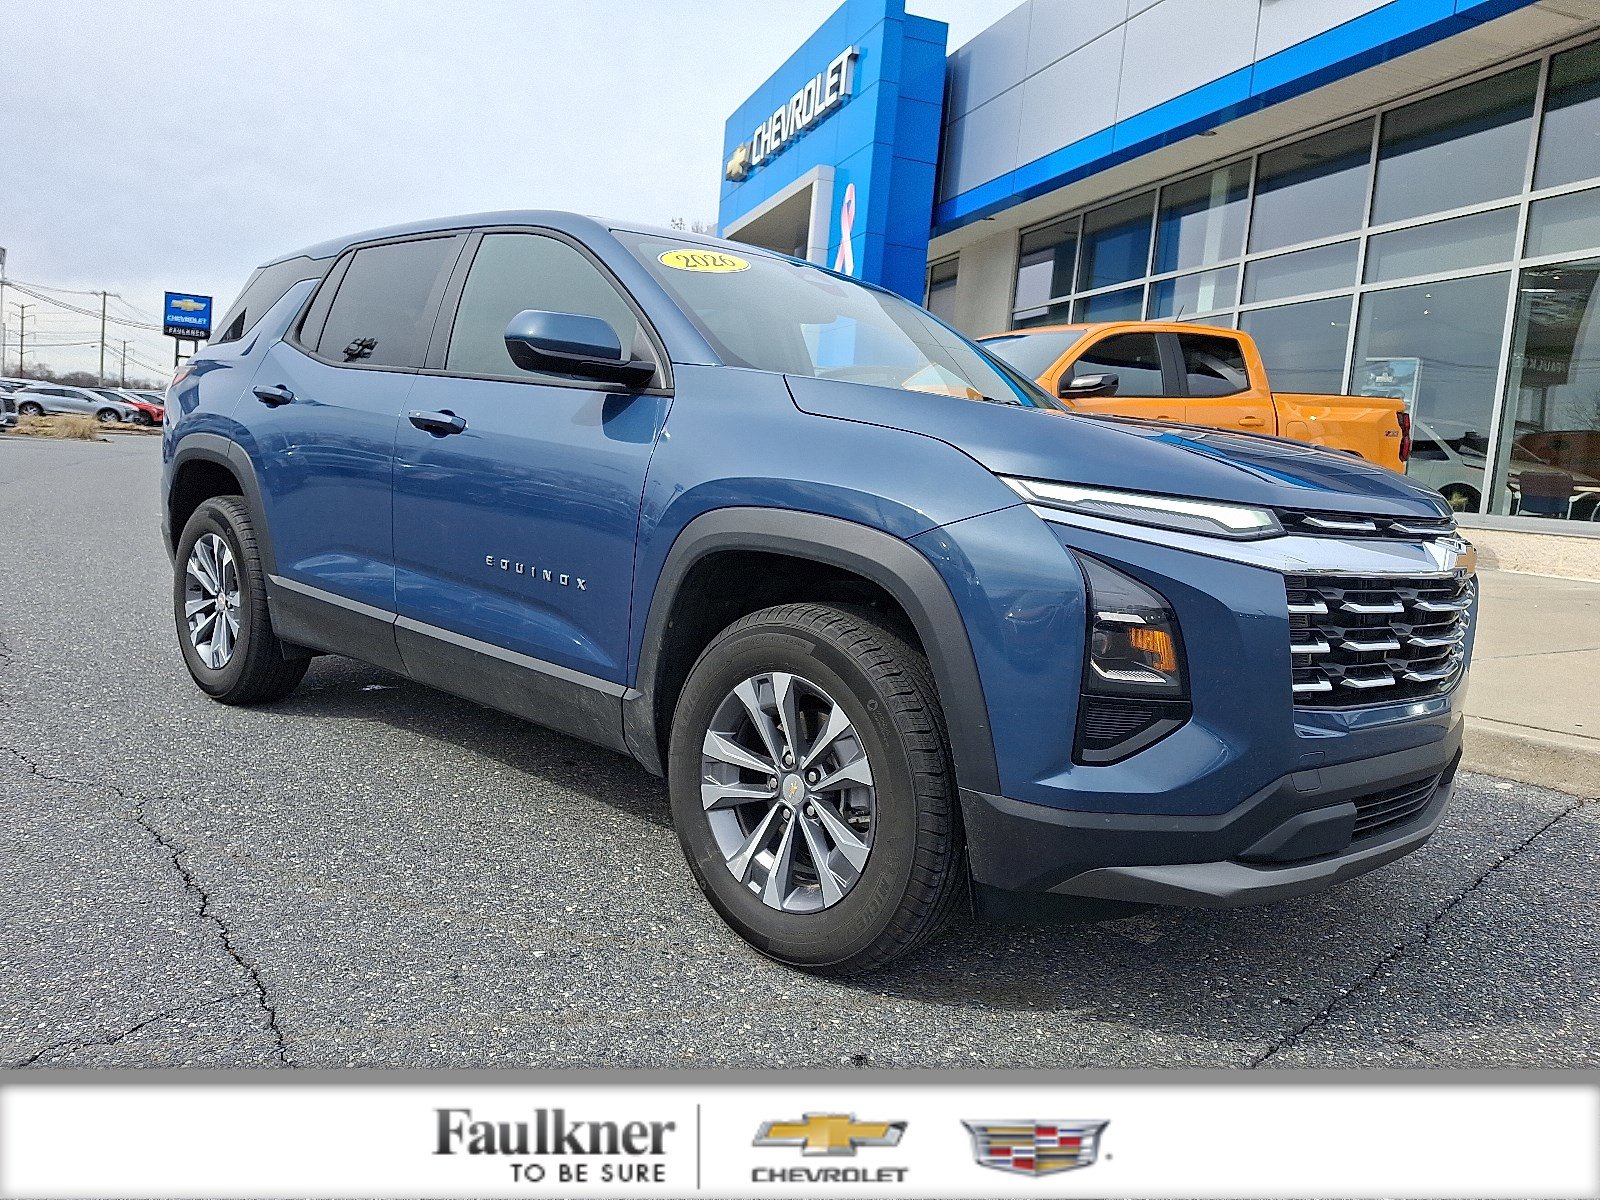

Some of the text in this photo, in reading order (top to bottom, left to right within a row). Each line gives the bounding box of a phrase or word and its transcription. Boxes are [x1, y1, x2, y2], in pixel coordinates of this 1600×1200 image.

[751, 44, 860, 166] CHEVROLET
[675, 253, 736, 269] 2026
[166, 314, 208, 325] CHEVROLET
[168, 326, 206, 337] FAULKNER
[485, 555, 588, 591] EQUINOX
